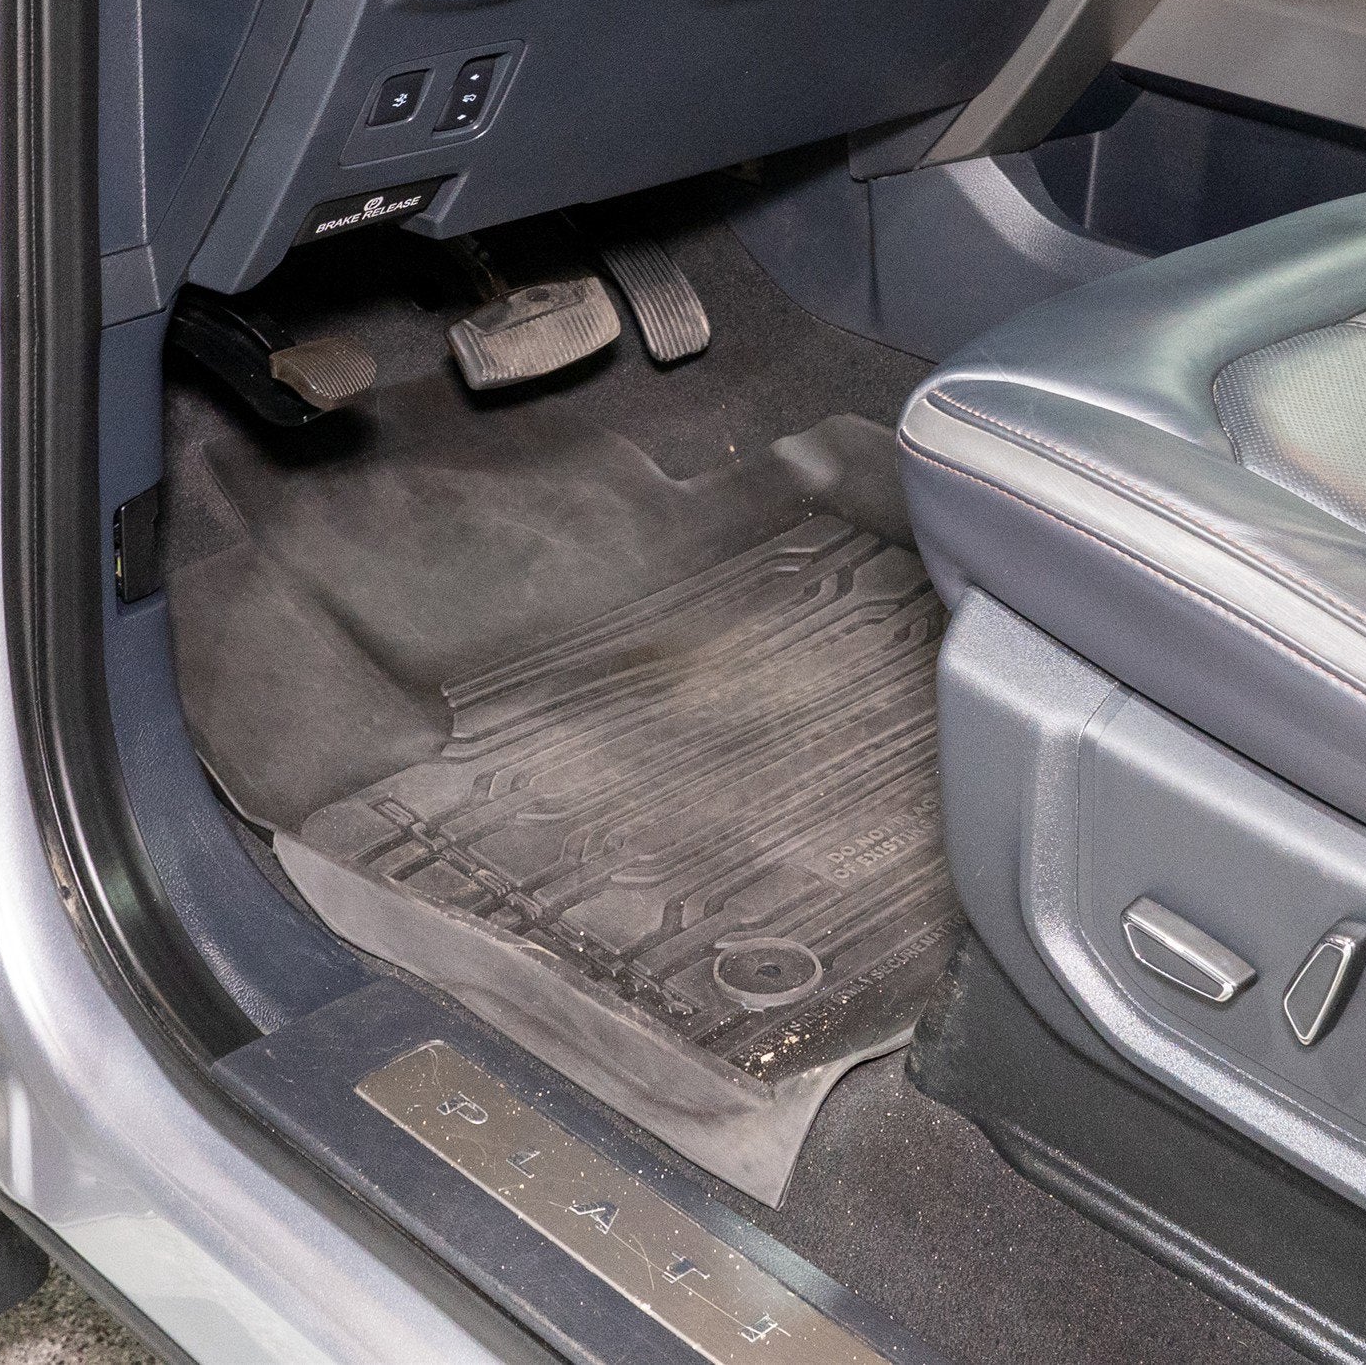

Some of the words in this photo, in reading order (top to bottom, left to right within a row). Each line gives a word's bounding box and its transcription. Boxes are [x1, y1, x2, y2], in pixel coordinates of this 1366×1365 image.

[315, 212, 362, 234] BRAKE
[362, 195, 422, 220] RELEASE
[826, 845, 857, 865] DO
[853, 824, 895, 849] NOT
[834, 862, 857, 879] OF
[854, 818, 937, 867] EXISTING
[870, 943, 926, 981] SECURE
